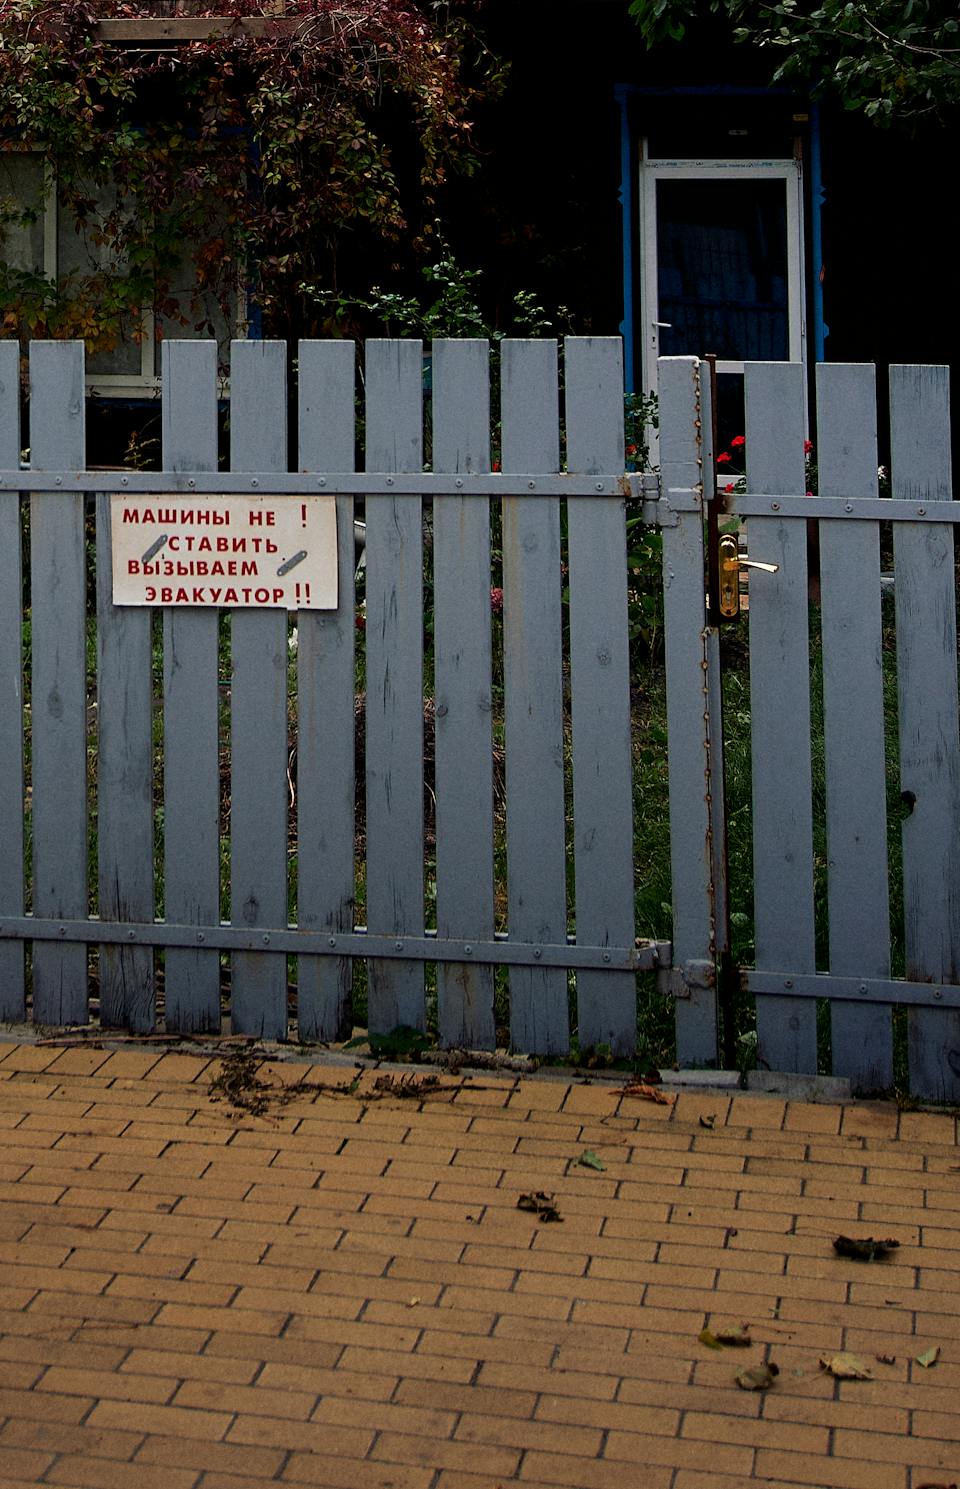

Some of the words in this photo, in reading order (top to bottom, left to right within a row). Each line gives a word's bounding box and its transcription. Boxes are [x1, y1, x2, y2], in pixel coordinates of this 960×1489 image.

[122, 507, 231, 526] МАШИНЫ
[248, 510, 276, 527] НЕ
[168, 535, 279, 554] СТАВИТЬ
[127, 559, 259, 577] ВЫЗЫВАЕМ
